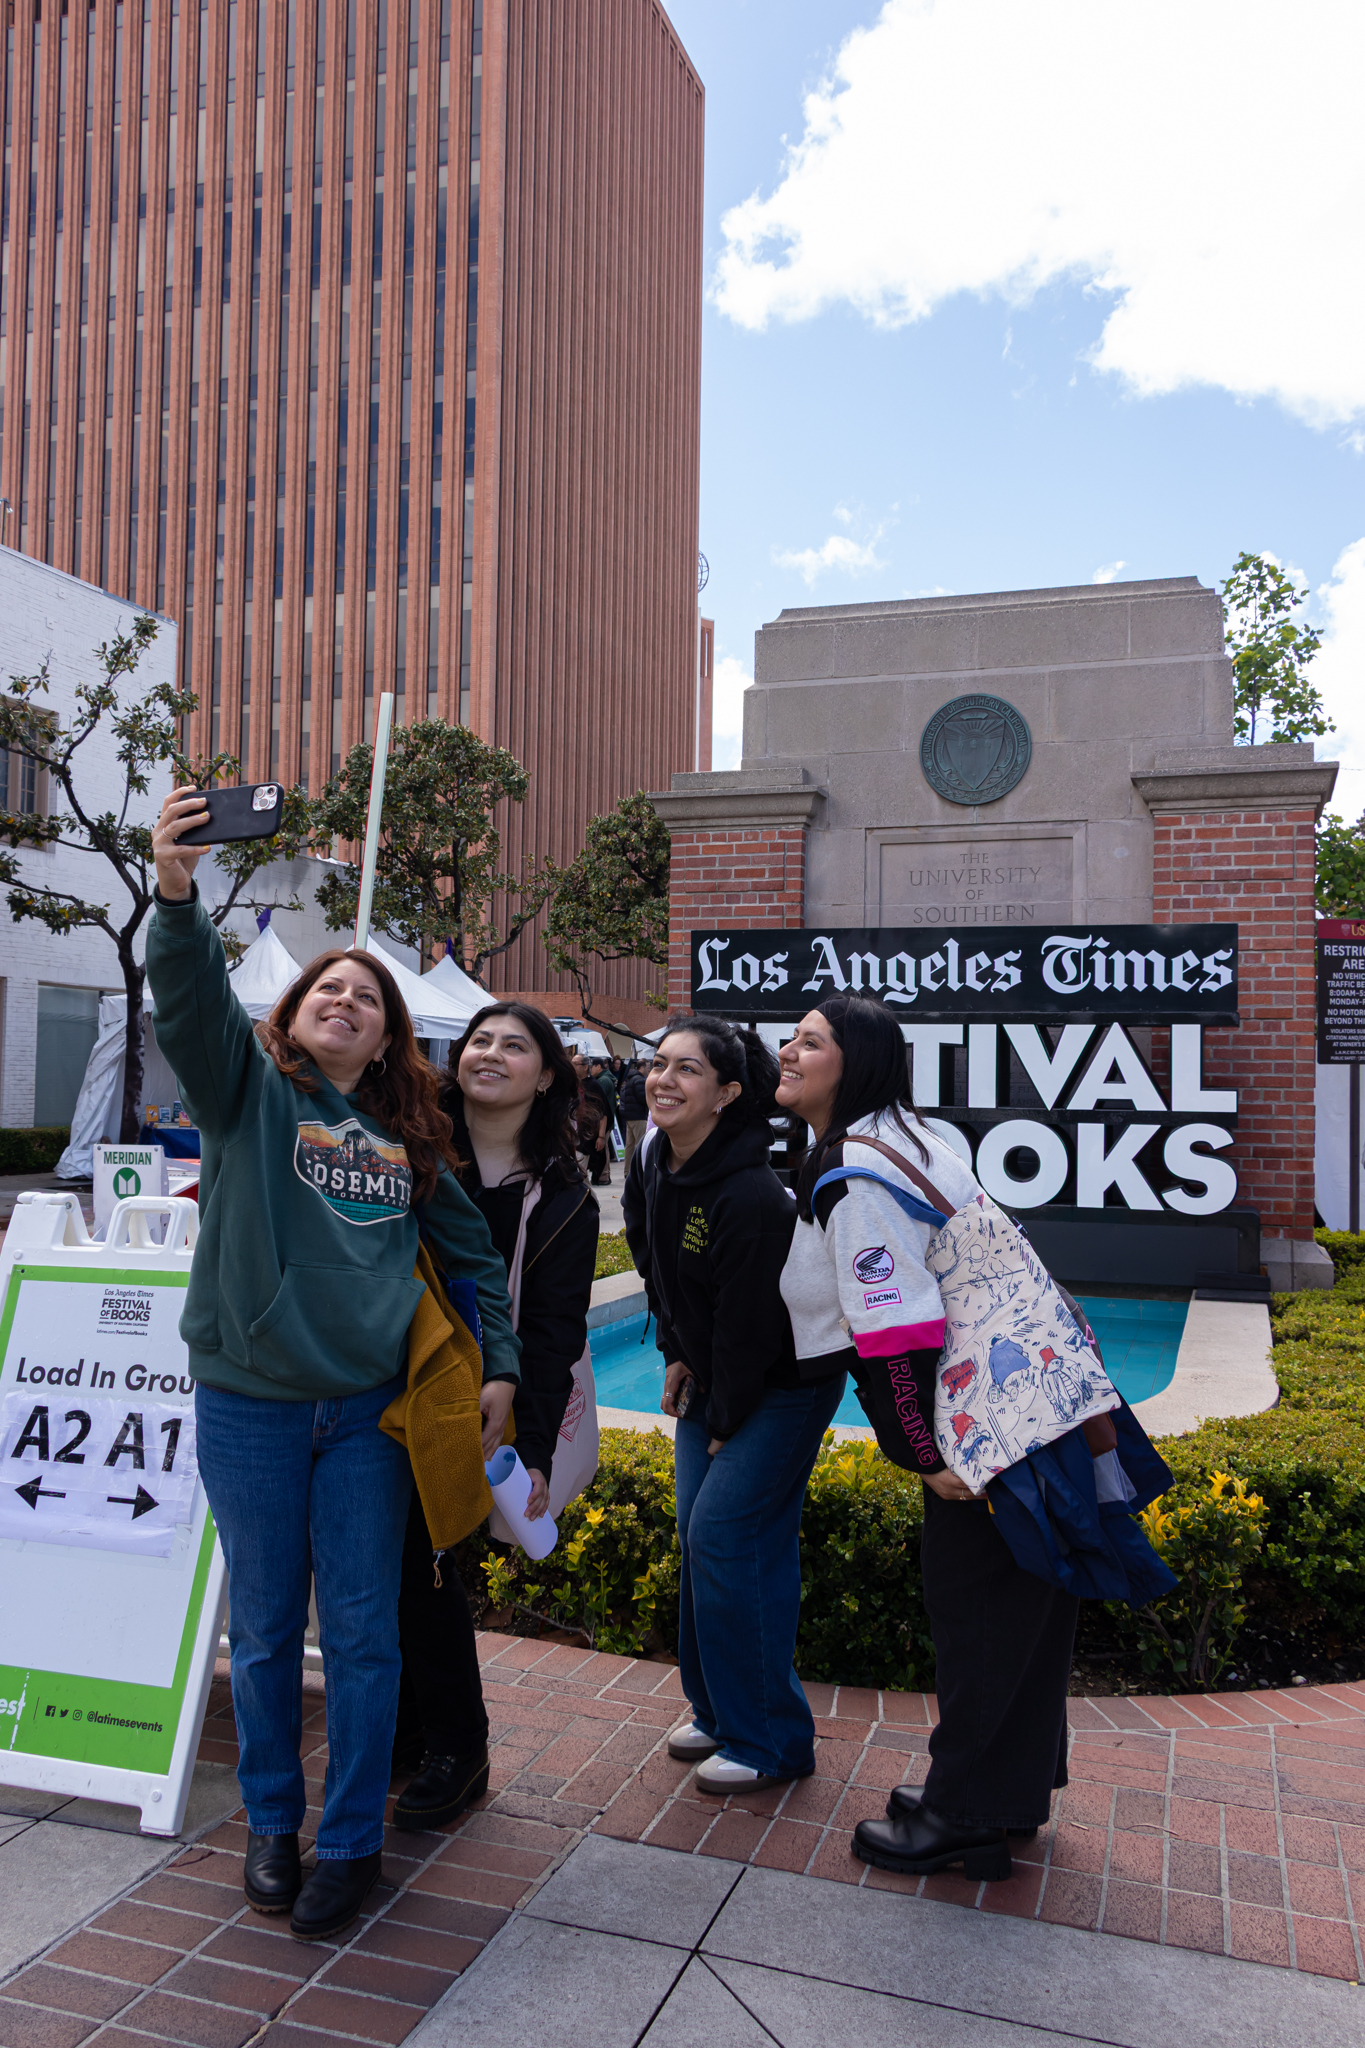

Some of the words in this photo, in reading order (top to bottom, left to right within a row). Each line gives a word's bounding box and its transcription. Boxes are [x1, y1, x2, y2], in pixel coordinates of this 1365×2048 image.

[923, 712, 946, 753] UNIVERSITY
[947, 703, 957, 713] OF
[960, 697, 1000, 710] SOUTHERN
[1001, 706, 1027, 747] CALIFORNIA
[960, 853, 989, 864] THE
[909, 867, 1042, 887] UNIVERSITY
[965, 889, 984, 900] OF
[913, 904, 1035, 924] SOUTHERN
[1351, 924, 1365, 936] US
[1324, 945, 1365, 957] RESTRI
[696, 937, 789, 993] Los
[801, 936, 1022, 1004] Angeles
[1040, 934, 1233, 995] Times
[1342, 959, 1365, 970] ARE
[1332, 972, 1343, 980] NO
[1344, 972, 1365, 980] VEHIC
[1327, 980, 1355, 988] TRAFFIC
[1327, 1008, 1338, 1016] NO
[1324, 1017, 1353, 1025] BEYOND
[733, 1022, 1237, 1113] TIVAL
[103, 1151, 152, 1166] MERIDIAN
[925, 1118, 1238, 1216] OKS
[324, 1188, 373, 1202] TIONAL
[858, 1267, 890, 1279] HONDA
[104, 1288, 114, 1296] Los
[115, 1289, 136, 1298] Angeles
[137, 1290, 154, 1298] Times
[867, 1293, 898, 1305] RACING
[102, 1298, 151, 1310] FESTIVAL
[100, 1309, 110, 1317] OF
[110, 1309, 150, 1322] BOOKS
[16, 1357, 85, 1387] Load
[90, 1362, 116, 1389] In
[125, 1364, 195, 1395] Grou
[887, 1358, 938, 1467] RACING
[11, 1405, 92, 1465] A2
[103, 1412, 183, 1473] A1
[87, 1711, 163, 1733] @latimesevents
